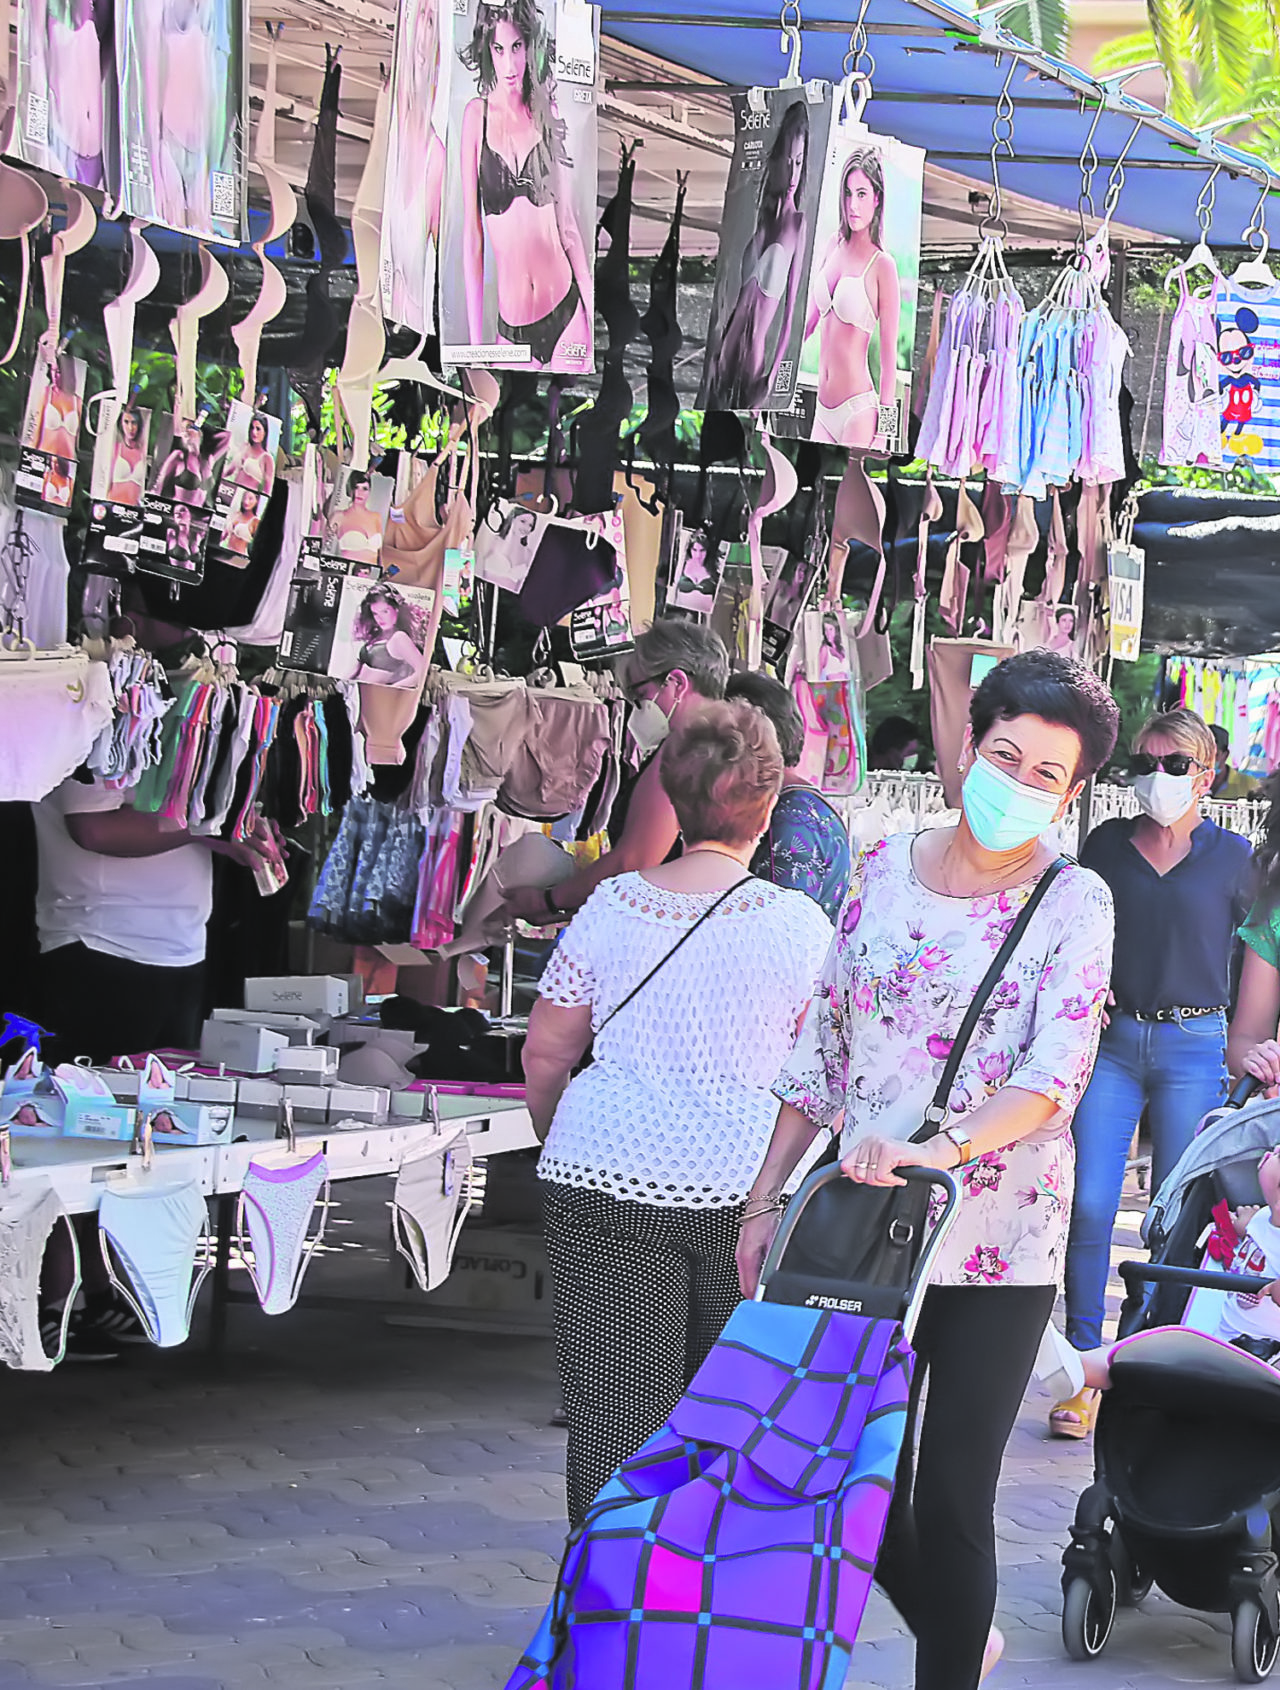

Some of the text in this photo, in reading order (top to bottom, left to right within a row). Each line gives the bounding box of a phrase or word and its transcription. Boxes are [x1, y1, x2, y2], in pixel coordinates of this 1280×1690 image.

[558, 55, 591, 78] Selene
[740, 109, 771, 131] Selene
[324, 576, 339, 608] Selene
[1109, 581, 1133, 622] VISA
[818, 1296, 862, 1313] ROLSER
